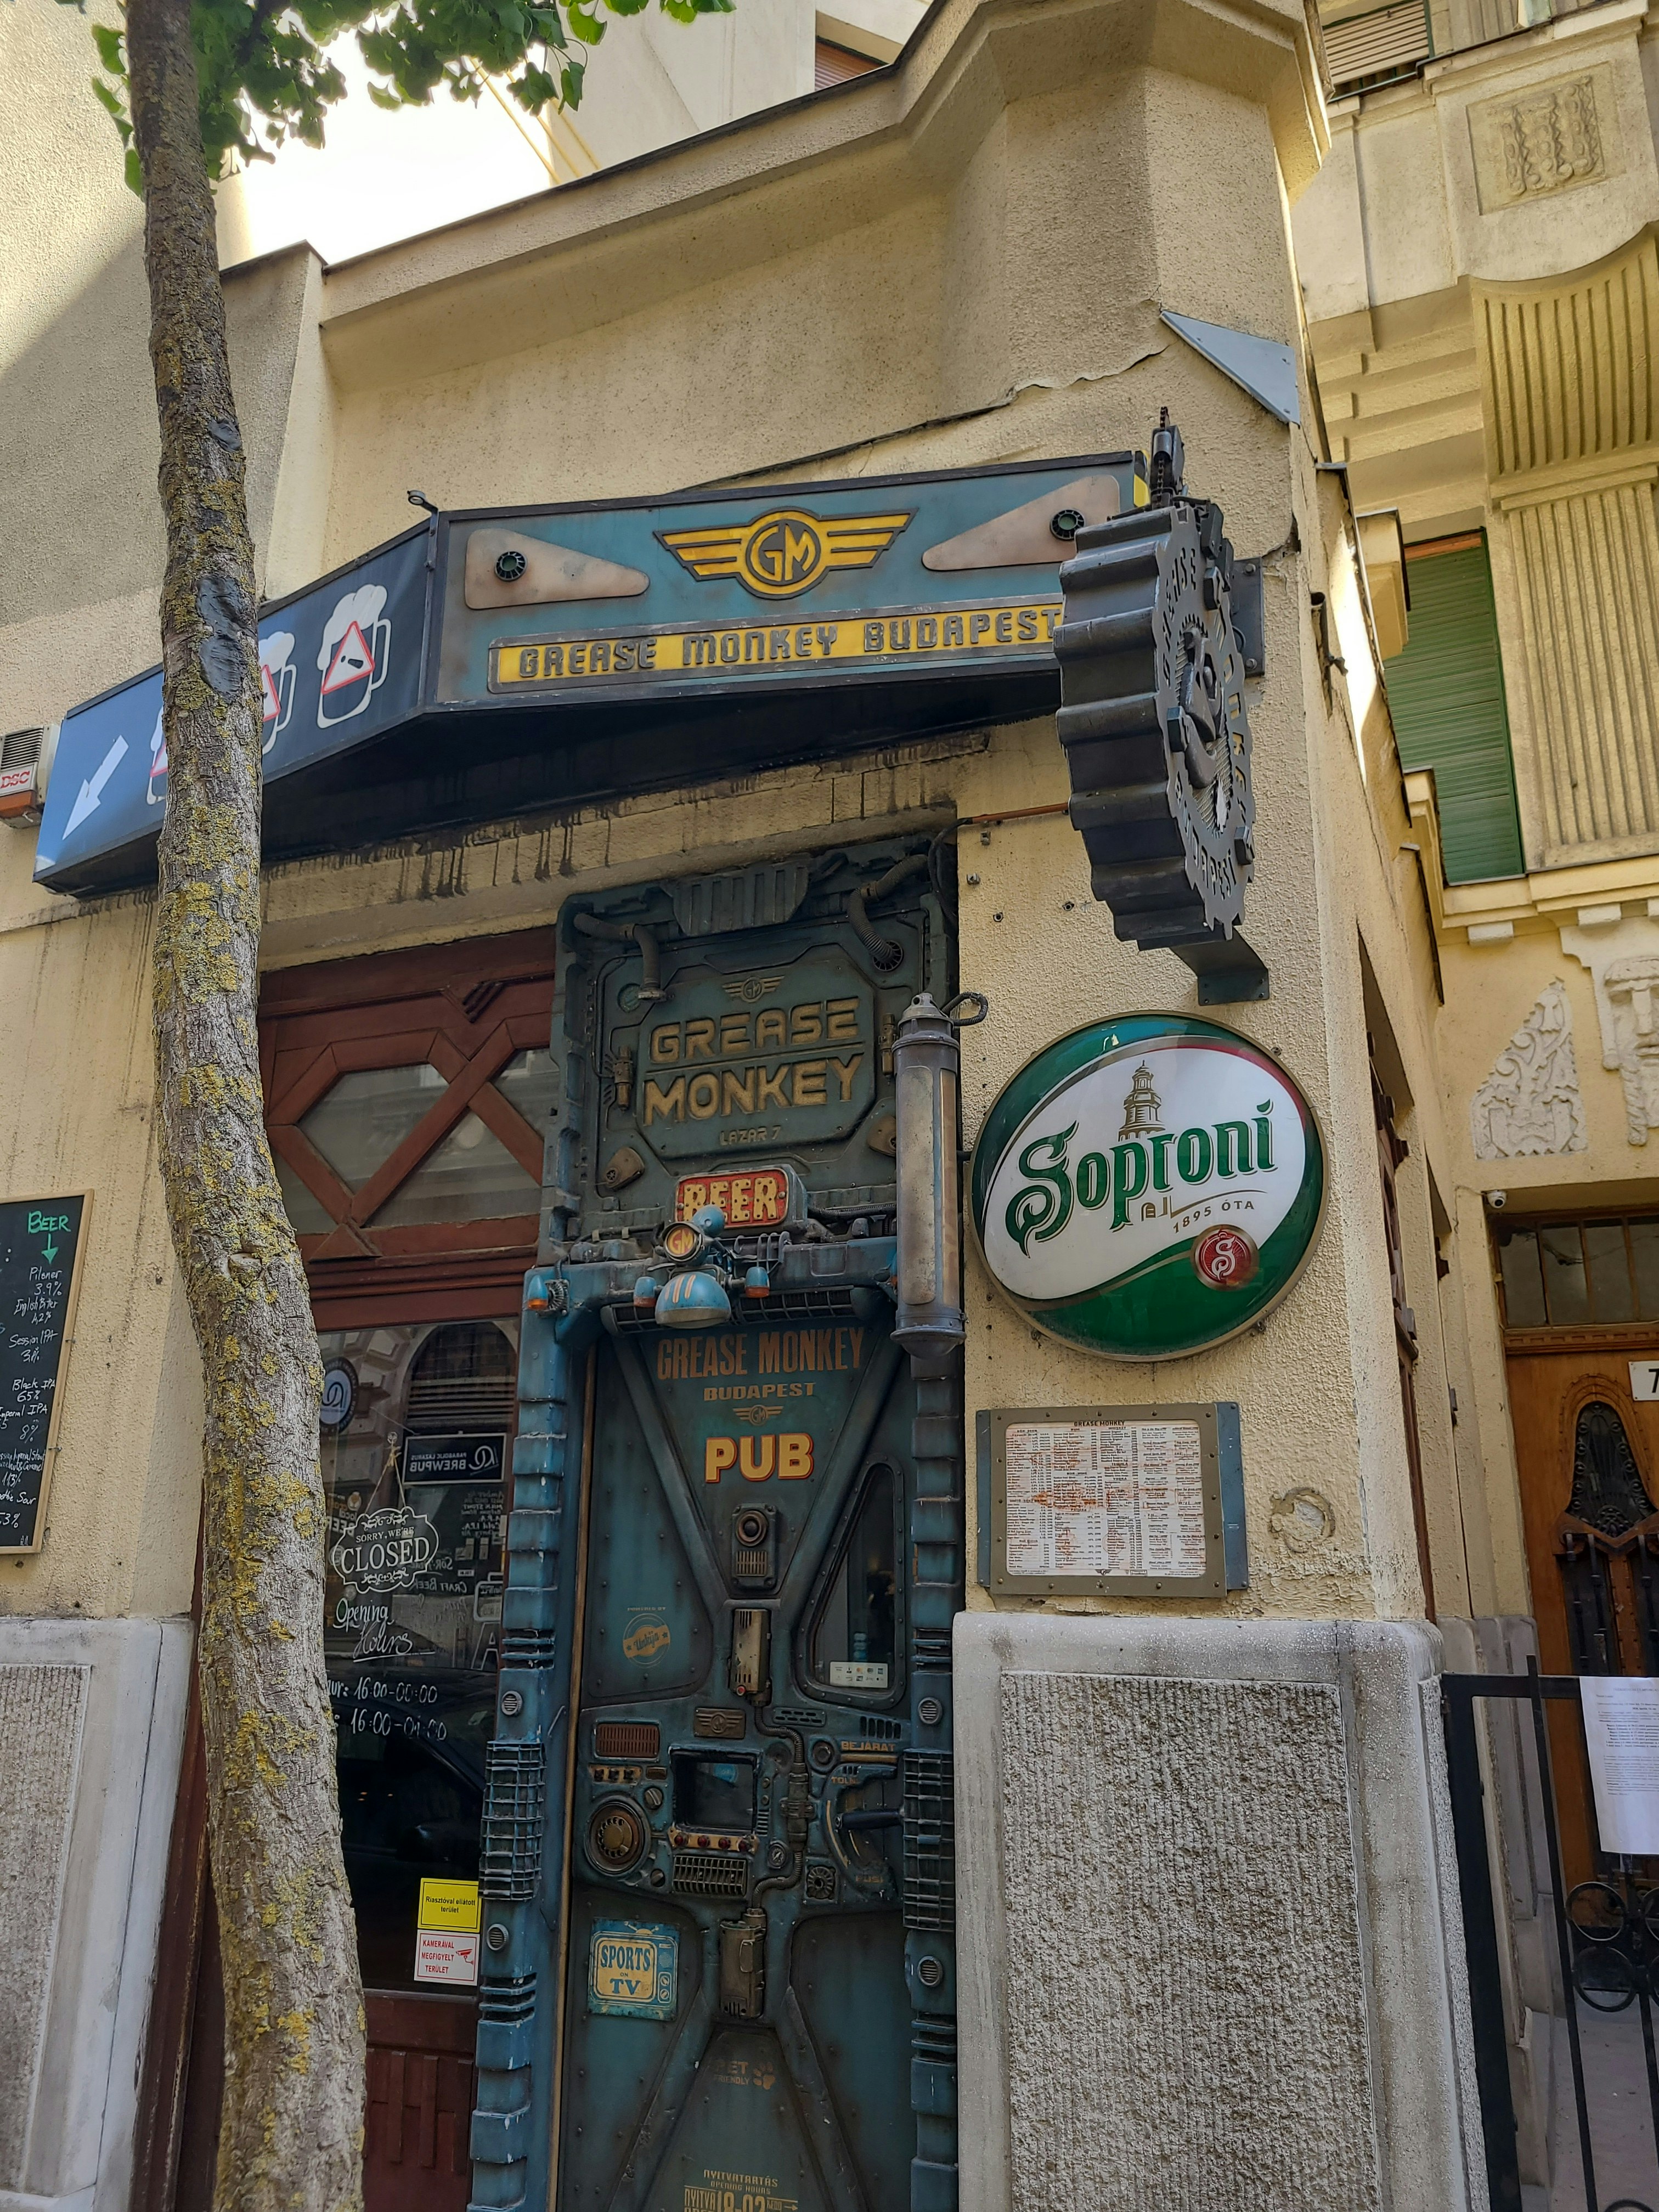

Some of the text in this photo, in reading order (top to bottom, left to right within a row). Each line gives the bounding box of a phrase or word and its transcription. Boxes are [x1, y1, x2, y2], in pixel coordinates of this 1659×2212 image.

[751, 522, 816, 583] GM
[520, 609, 1061, 678] GREASE MONKEY BUDAPEST
[0, 770, 30, 789] DSC
[650, 996, 859, 1063] GREASE
[642, 1052, 865, 1126] MONKEY
[720, 1126, 782, 1146] LAZAR 7
[1005, 1098, 1278, 1259] Soproni
[683, 1177, 777, 1222] BEER
[1172, 1199, 1255, 1234] 1895 ÓTA
[668, 1229, 695, 1255] GM
[658, 1327, 864, 1380] GREASE MONKEY
[703, 1382, 817, 1401] BUDAPEST
[27, 1403, 48, 1415] IPA
[704, 1432, 814, 1483] PUB
[341, 1536, 430, 1574] CLOSED
[335, 1597, 390, 1633] Opening
[353, 1620, 413, 1659] Hours
[426, 1896, 455, 1905] Riasztóval
[421, 1952, 454, 1961] MEGFIGYELT
[423, 1939, 454, 1949] KAMERÁVAL
[425, 1965, 449, 1973] TERÜLET
[600, 1945, 651, 1972] SPORTS
[609, 1978, 640, 1996] TV
[703, 2169, 778, 2187] NYITVATARTÁS
[685, 2188, 716, 2210] NYITVA
